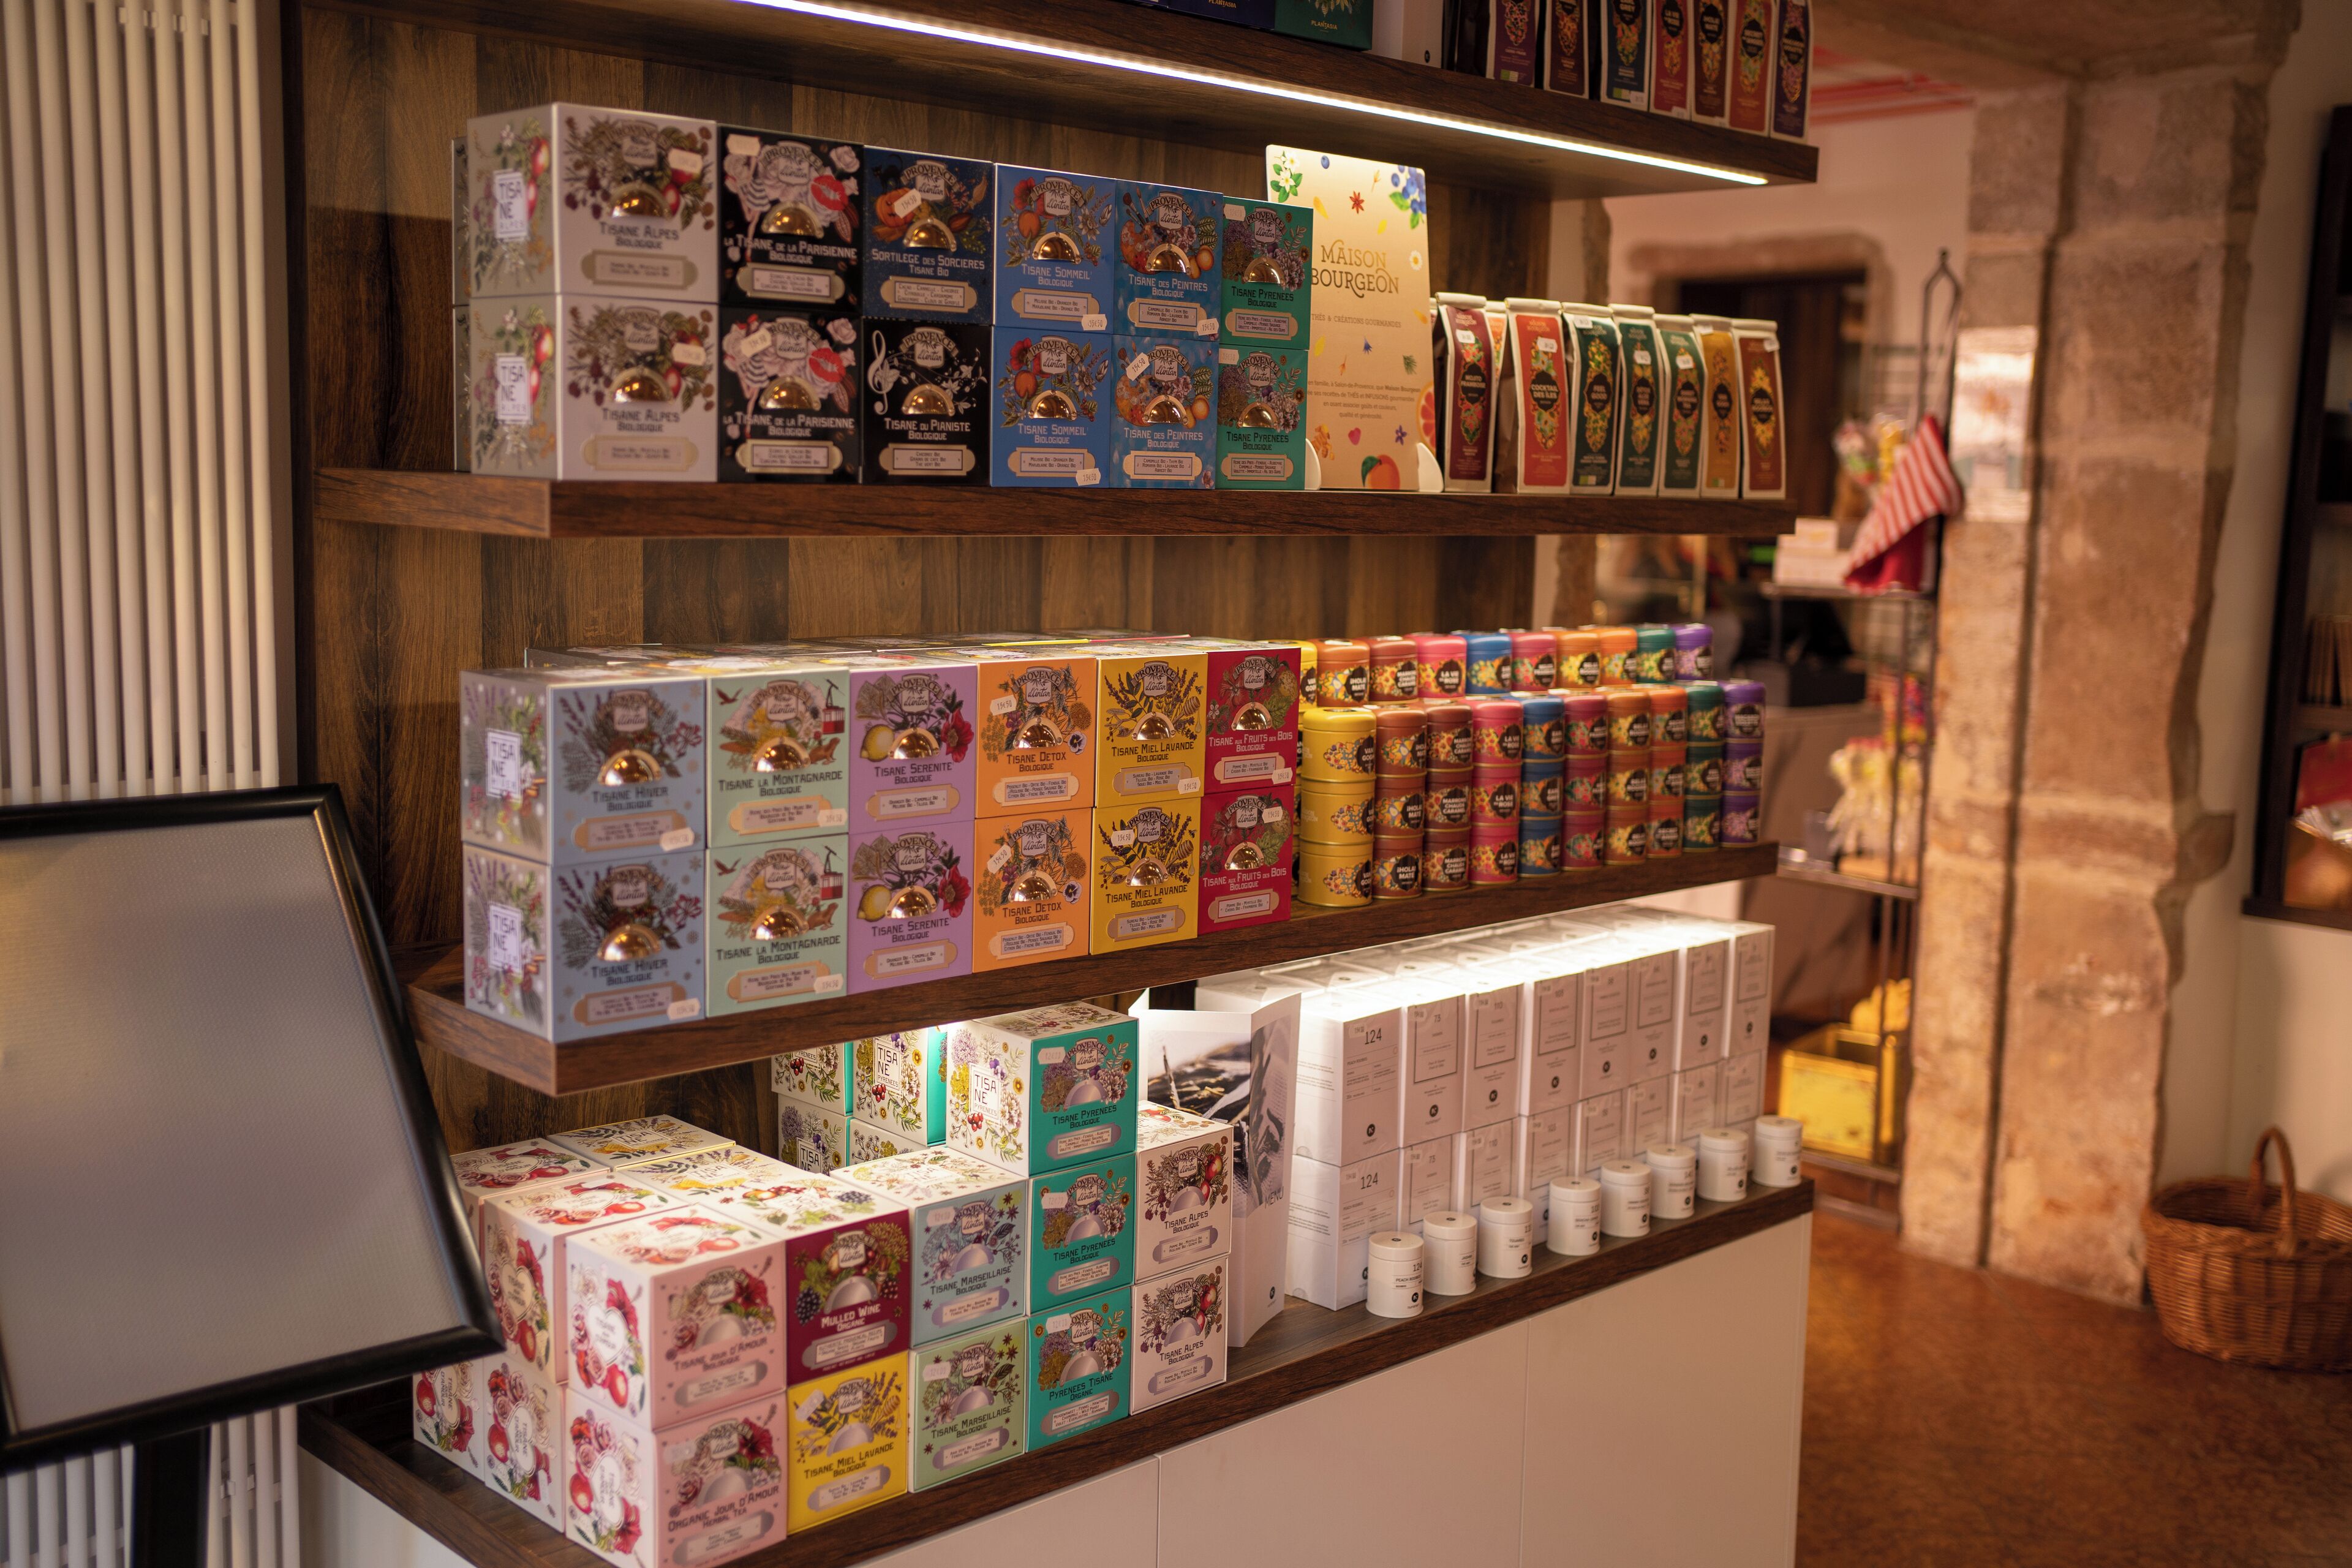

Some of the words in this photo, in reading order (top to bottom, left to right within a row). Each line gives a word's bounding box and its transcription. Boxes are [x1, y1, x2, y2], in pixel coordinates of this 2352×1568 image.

[1311, 20, 1338, 31] PLANTASIA
[906, 164, 956, 184] PROVENCE
[1036, 181, 1081, 200] PROVENCE
[1150, 196, 1191, 215] PROVENCE
[1246, 212, 1284, 229] PROVENCE
[600, 222, 639, 238] TISANE
[644, 225, 679, 240] ALPES
[871, 249, 920, 265] SORTILEGE
[922, 258, 935, 266] DES
[938, 255, 985, 270] SORCIERES
[1321, 239, 1386, 268] MAISON
[909, 265, 933, 276] TISANE
[937, 268, 949, 277] BIO
[1022, 264, 1053, 275] TISANE
[1055, 266, 1090, 279] SOMMEIL
[1038, 277, 1074, 287] BIOLOGIQUE
[1128, 274, 1156, 287] TISANE
[1171, 279, 1208, 292] PEINTRES
[1311, 267, 1399, 298] BOURGEON
[1152, 289, 1185, 298] BIOLOGIQUE
[1231, 287, 1256, 298] TISANE
[1258, 288, 1294, 301] PYRENEES
[1247, 299, 1277, 308] BIOLOGIQUE
[1334, 314, 1364, 325] CRÉATIONS
[1365, 319, 1401, 328] GOURMANDES
[904, 333, 956, 351] PROVENCE
[1031, 341, 1077, 358] PROVENCE
[1133, 358, 1145, 372] 15€50
[1241, 356, 1278, 372] PROVENCE
[601, 408, 640, 422] TISANE
[644, 410, 680, 422] ALPES
[734, 412, 772, 427] TISANE
[797, 415, 854, 429] PARISIENNE
[884, 418, 917, 431] TISANE
[930, 420, 970, 431] PIANISTE
[1018, 423, 1048, 435] TISANE
[1051, 424, 1087, 436] SOMMEIL
[908, 431, 947, 440] BIOLOGIQUE
[1035, 435, 1069, 444] BIOLOGIQUE
[1124, 428, 1151, 438] TISANE
[1167, 430, 1203, 440] PEINTRES
[1226, 432, 1251, 442] TISANE
[1254, 432, 1289, 443] PYRENEES
[1147, 440, 1180, 448] BIOLOGIQUE
[1243, 442, 1272, 451] BIOLOGIQUE
[1136, 665, 1176, 679] PROVENCE
[1236, 659, 1273, 673] PROVENCE
[1017, 671, 1060, 684] PROVENCE
[892, 679, 940, 695] PROVENCE
[997, 701, 1012, 710] 15€50
[1209, 737, 1234, 747] TISANE
[1244, 734, 1267, 744] FRUITS
[1277, 731, 1293, 741] BOIS
[1112, 746, 1139, 757] TISANE
[1141, 744, 1159, 754] MIEL
[1161, 741, 1194, 752] LAVANDE
[1006, 753, 1036, 764] TISANE
[1040, 752, 1066, 761] DETOX
[874, 766, 907, 777] TISANE
[910, 762, 952, 774] SERENITE
[718, 778, 755, 792] TISANE
[772, 771, 843, 786] MONTAGNARDE
[1129, 811, 1169, 826] PROVENCE
[1012, 822, 1057, 839] PROVENCE
[993, 850, 1007, 865] 15€50
[1203, 876, 1226, 888] TISANE
[1237, 871, 1261, 883] FRUITS
[1271, 867, 1287, 877] BOIS
[1106, 892, 1133, 904] TISANE
[1135, 889, 1153, 900] MIEL
[1154, 885, 1188, 897] LAVANDE
[1003, 906, 1031, 918] TISANE
[1035, 902, 1062, 914] DETOX
[872, 924, 903, 937] TISANE
[908, 918, 949, 932] SERENITE
[716, 948, 752, 962] TISANE
[771, 935, 841, 953] MONTAGNARDE
[1364, 1027, 1382, 1045] 124
[878, 1047, 898, 1065] TISA
[878, 1063, 890, 1077] NE
[877, 1076, 899, 1088] PYRENEES
[974, 1074, 997, 1093] TISA
[974, 1090, 987, 1105] NE
[974, 1102, 997, 1117] PYRENEES
[1052, 1113, 1078, 1125] TISANE
[1081, 1104, 1117, 1119] PYRENEES
[801, 1147, 820, 1166] TISA
[1360, 1172, 1379, 1190] 124
[1264, 1186, 1284, 1210] MENU
[1164, 1218, 1187, 1230] TISANE
[1189, 1210, 1208, 1222] ALPES
[1054, 1249, 1079, 1261] TISANE
[1081, 1238, 1116, 1254] PYRENEES
[930, 1281, 958, 1295] TISANE
[961, 1266, 1012, 1286] MARSEILLAISE
[821, 1311, 856, 1328] MULLED
[858, 1303, 881, 1317] WINE
[1159, 1348, 1183, 1362] TISANE
[1184, 1340, 1204, 1352] ALPES
[1049, 1382, 1086, 1401] PYRENEES
[1089, 1372, 1113, 1386] TISANE
[1070, 1389, 1093, 1401] ORGANIC
[931, 1424, 959, 1439] TISANE
[962, 1406, 1011, 1429] MARSEILLAISE
[804, 1463, 834, 1479] TISANE
[837, 1457, 856, 1467] MIEL
[859, 1442, 894, 1461] LAVANDE
